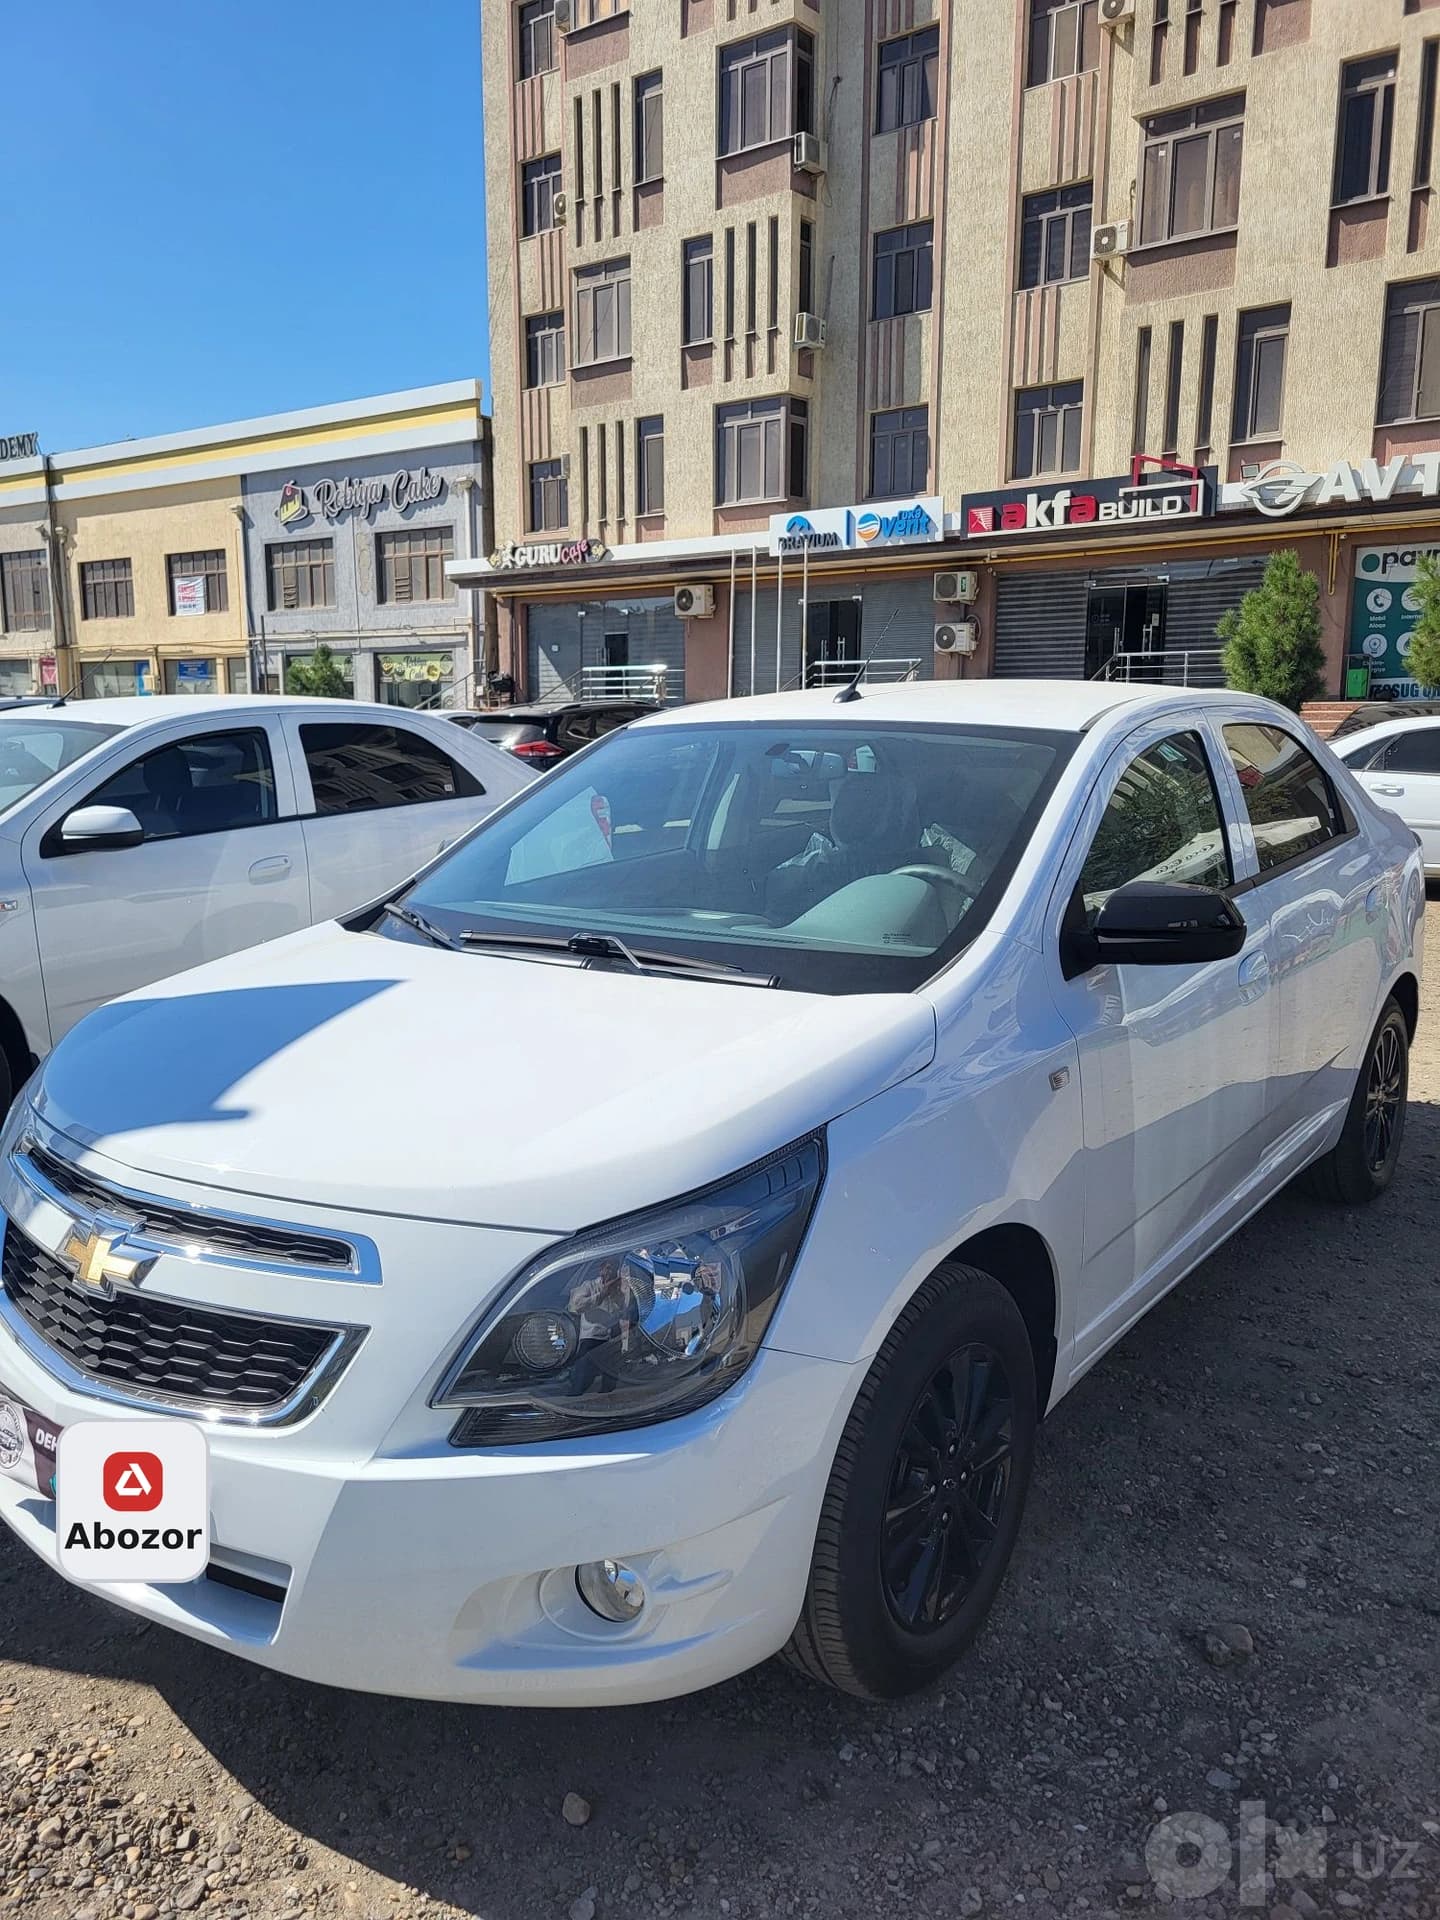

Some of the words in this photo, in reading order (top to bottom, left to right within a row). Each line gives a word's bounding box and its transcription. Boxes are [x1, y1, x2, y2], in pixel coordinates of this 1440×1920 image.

[391, 467, 443, 513] Cake
[1316, 452, 1440, 505] AVT
[1001, 490, 1096, 530] akfa
[1099, 495, 1182, 521] BUILD
[515, 544, 562, 566] GURU
